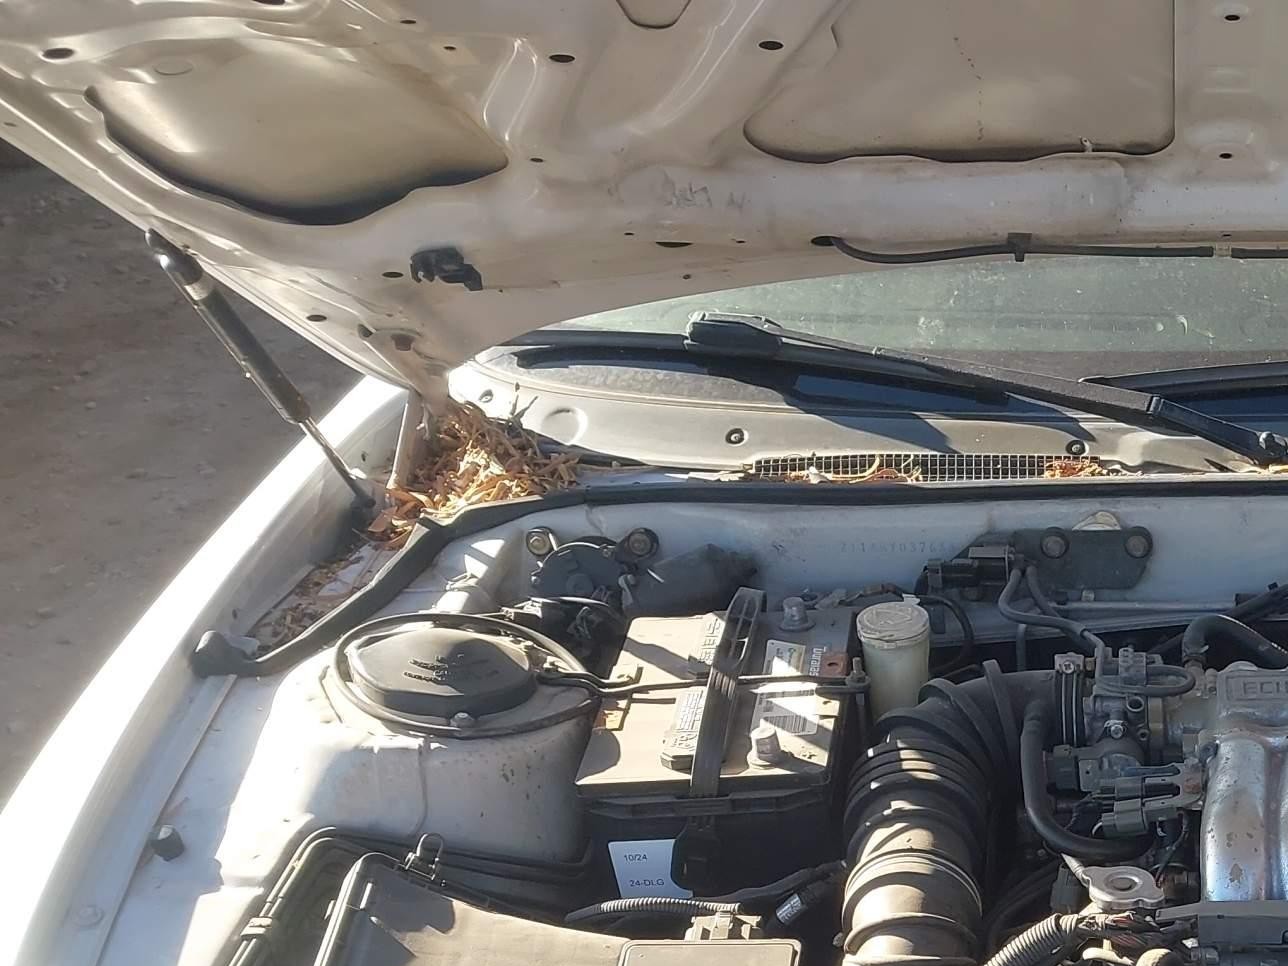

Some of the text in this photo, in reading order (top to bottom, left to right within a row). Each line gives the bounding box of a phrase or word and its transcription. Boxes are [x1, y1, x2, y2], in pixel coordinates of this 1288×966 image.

[809, 646, 828, 677] Duralas
[624, 853, 648, 862] 10/24
[629, 878, 665, 888] 24-DLG
